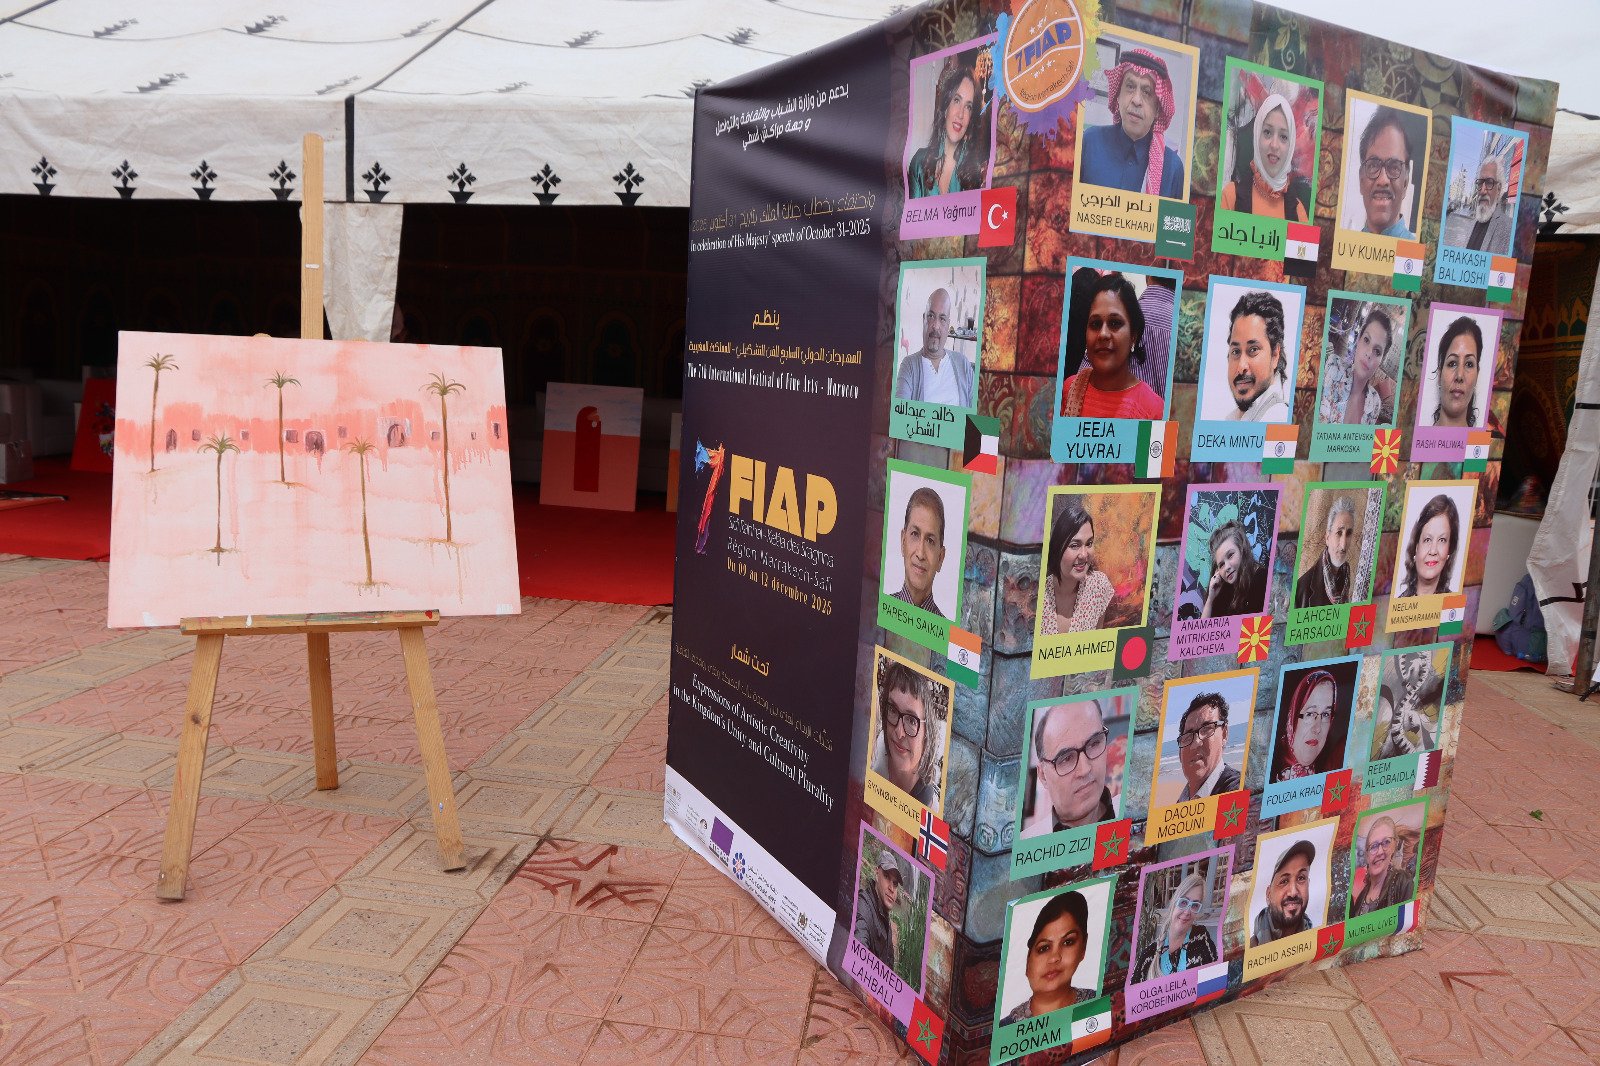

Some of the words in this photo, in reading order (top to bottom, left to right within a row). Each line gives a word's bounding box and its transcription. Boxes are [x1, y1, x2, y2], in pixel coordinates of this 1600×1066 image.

[798, 93, 815, 112] وزارة
[817, 90, 827, 108] من
[828, 83, 849, 105] بدعم
[740, 107, 771, 125] والثقافة
[771, 98, 797, 119] الشباب
[715, 115, 740, 136] والتواصل
[785, 120, 803, 133] جهة
[1080, 193, 1121, 209] الخرجي
[1126, 200, 1152, 213] ناصر
[905, 207, 939, 223] BELMA
[942, 205, 977, 222] Yağmur
[1077, 211, 1112, 226] NASSER
[1115, 218, 1155, 233] ELKHARJI
[734, 234, 745, 248] His
[771, 227, 794, 248] speech
[795, 226, 806, 241] of
[806, 224, 835, 241] October
[1218, 222, 1249, 246] جاد
[1251, 225, 1280, 252] رانيا
[1338, 242, 1346, 256] U
[1348, 243, 1358, 258] V
[1358, 245, 1395, 263] KUMAR
[1442, 249, 1487, 268] PRAKASH
[1438, 266, 1456, 281] BAL
[1459, 270, 1486, 286] JOSHI
[753, 309, 780, 330] ينظم
[780, 346, 800, 364] السابع
[801, 347, 825, 364] الدولي
[826, 349, 862, 367] المهرجان
[708, 365, 747, 385] International
[749, 368, 775, 388] Festival
[776, 372, 784, 389] of
[785, 373, 800, 392] Fine
[803, 375, 819, 394] Arts
[827, 377, 859, 399] Morocco
[932, 406, 955, 423] خالد
[1075, 421, 1116, 438] JEEJA
[1316, 432, 1341, 441] TATJANA
[1342, 432, 1374, 441] ANTEVSKA
[1066, 442, 1122, 459] YUVRAJ
[1197, 434, 1226, 448] DEKA
[1229, 435, 1264, 449] MINTU
[1326, 445, 1361, 453] MARKOSKA
[1415, 440, 1436, 449] RASHI
[1437, 440, 1465, 450] PALIWAL
[728, 453, 838, 543] FIAP
[727, 556, 736, 572] Du
[771, 576, 808, 604] décembre
[811, 593, 832, 616] 2025
[882, 603, 914, 626] PARESH
[1296, 608, 1341, 624] LAHCEN
[1392, 602, 1418, 612] NEELAM
[1181, 617, 1230, 631] ANAMARIJA
[1289, 624, 1343, 642] FARSAOUI
[1177, 630, 1231, 645] MITRIKJESKA
[731, 644, 751, 666] شعار
[1038, 644, 1072, 660] NAEIA
[1074, 640, 1115, 657] AHMED
[1180, 645, 1225, 657] KALCHEVA
[751, 654, 770, 677] تحت
[692, 672, 731, 711] Expressions
[731, 702, 741, 717] of
[740, 706, 768, 736] Artistic
[769, 725, 810, 769] Creativity
[673, 682, 680, 698] in
[681, 688, 691, 705] the
[727, 719, 747, 748] Unity
[748, 738, 762, 756] and
[763, 745, 796, 781] Cultural
[798, 768, 834, 813] Plurality
[1368, 762, 1391, 776] REEM
[1266, 792, 1297, 806] FOUZIA
[898, 801, 921, 823] HOLTE
[1164, 802, 1205, 823] DAOUD
[1157, 817, 1205, 839] MGOUNI
[1015, 841, 1066, 867] RACHID
[1068, 836, 1091, 854] ZIZI
[1347, 924, 1375, 940] MURIEL
[1377, 914, 1398, 932] LIVET
[1247, 952, 1279, 970] RACHID
[1281, 940, 1312, 958] ASSIRAJ
[851, 939, 903, 993] MOHAMED
[851, 961, 894, 1008] LAHBALI
[1139, 986, 1163, 1001] OLGA
[1164, 978, 1187, 994] LEILA
[1131, 987, 1197, 1016] KOROBEINIKOVA
[1016, 1016, 1051, 1038] RANI
[999, 1028, 1062, 1060] POONAM
